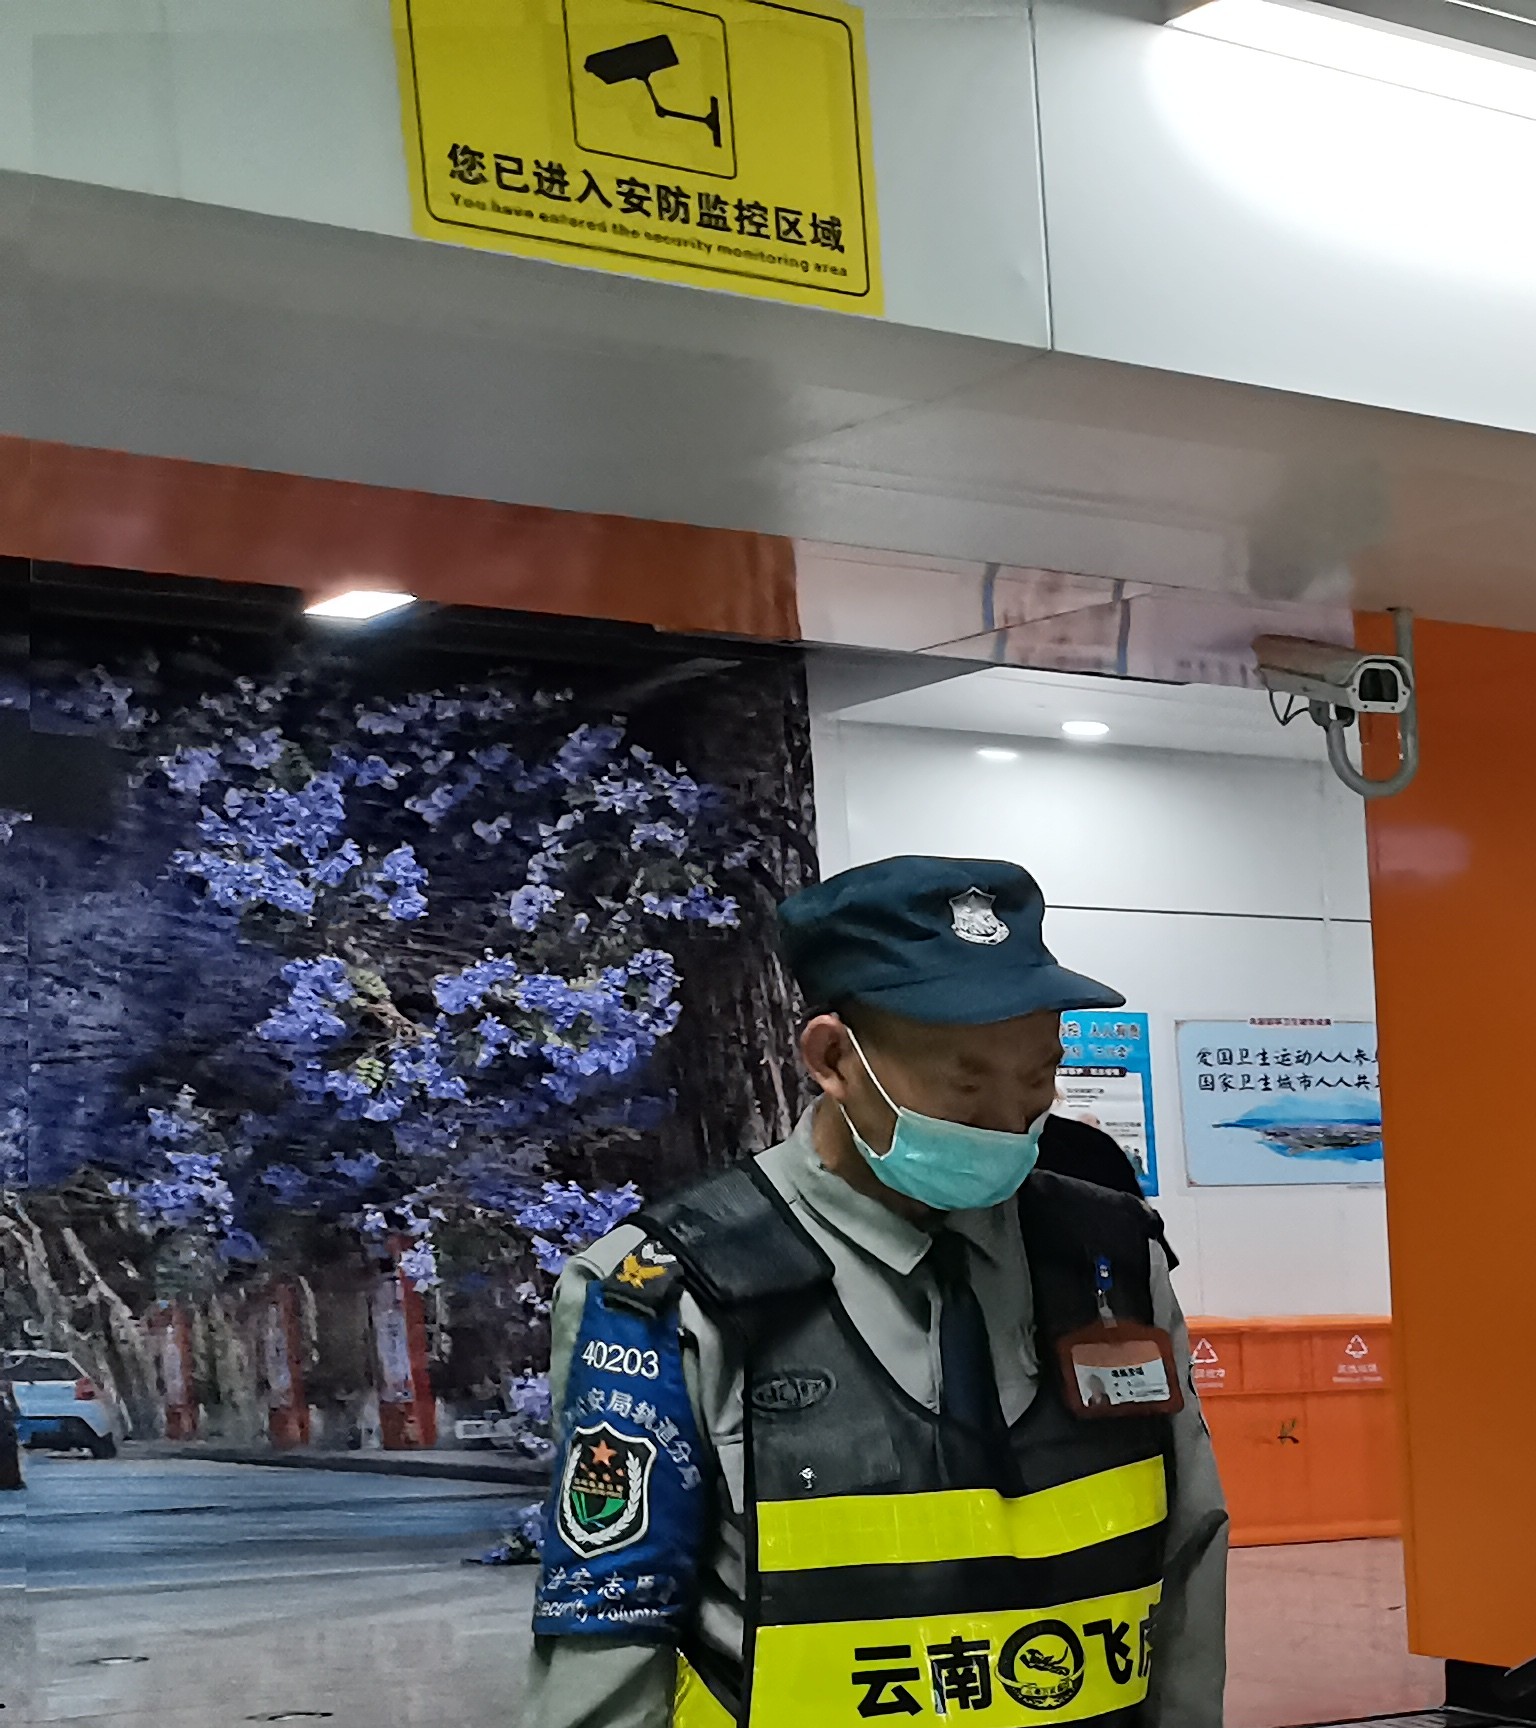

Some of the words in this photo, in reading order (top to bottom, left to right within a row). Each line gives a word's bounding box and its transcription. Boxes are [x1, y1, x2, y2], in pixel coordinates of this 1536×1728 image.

[447, 143, 845, 254] 您已进入安防监控区域
[450, 192, 487, 211] You
[490, 200, 535, 219] have
[539, 212, 608, 233] entered
[611, 222, 641, 239] the
[644, 231, 713, 254] security
[717, 244, 809, 272] monitoring
[814, 263, 848, 277] area
[1196, 1047, 1378, 1067] 爱国卫生运动人人参
[1198, 1072, 1380, 1092] 国家卫生城市人人共
[581, 1340, 659, 1379] 40203
[851, 1635, 993, 1718] 云南
